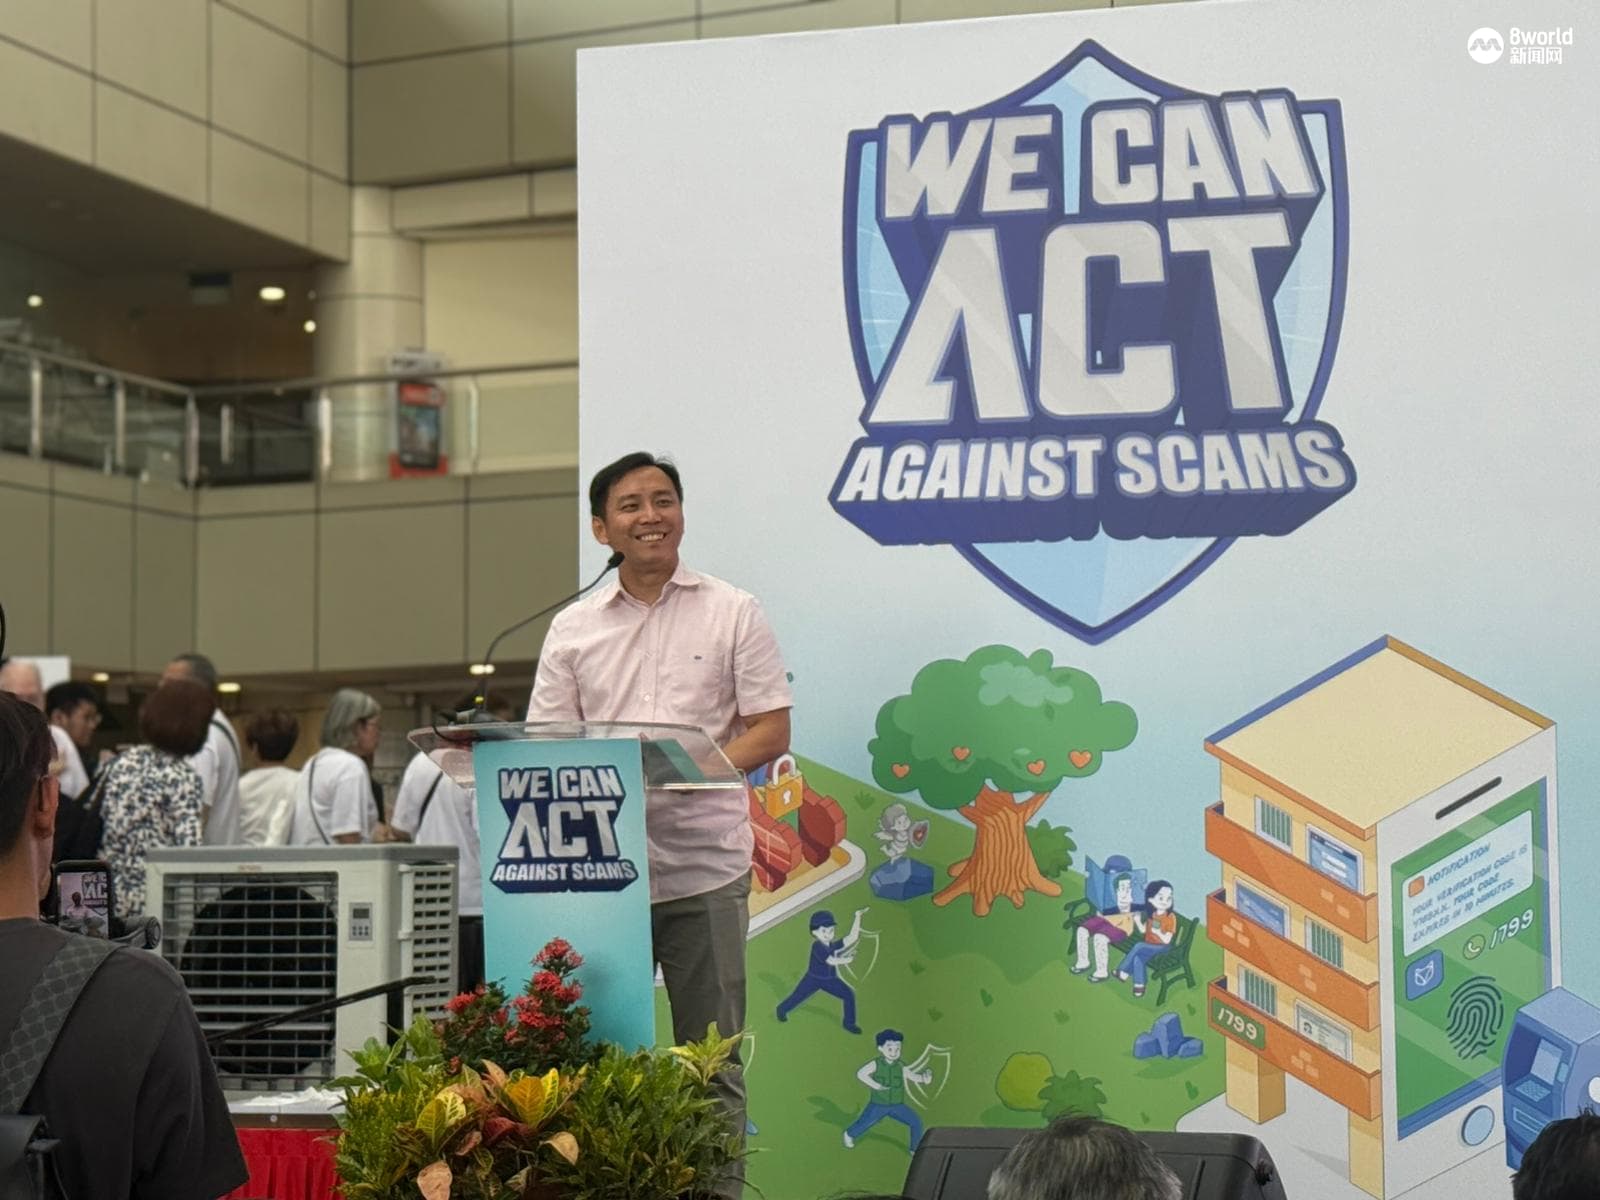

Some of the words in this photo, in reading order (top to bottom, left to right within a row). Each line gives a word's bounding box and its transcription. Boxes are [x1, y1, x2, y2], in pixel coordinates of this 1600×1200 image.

[884, 114, 1054, 219] WE
[1091, 98, 1318, 205] CAN
[867, 212, 1292, 424] ACT
[836, 437, 1103, 502] AGAINST
[1116, 429, 1348, 496] SCAMS
[501, 769, 550, 799] WE
[559, 768, 624, 798] CAN
[500, 801, 619, 859] ACT
[492, 863, 569, 881] AGAINST
[572, 862, 637, 880] SCAMS
[1427, 842, 1491, 886] NOTIFICATION
[1437, 863, 1491, 901] VERIFICATION
[1489, 908, 1534, 949] 1799
[1217, 1007, 1258, 1040] 1799
